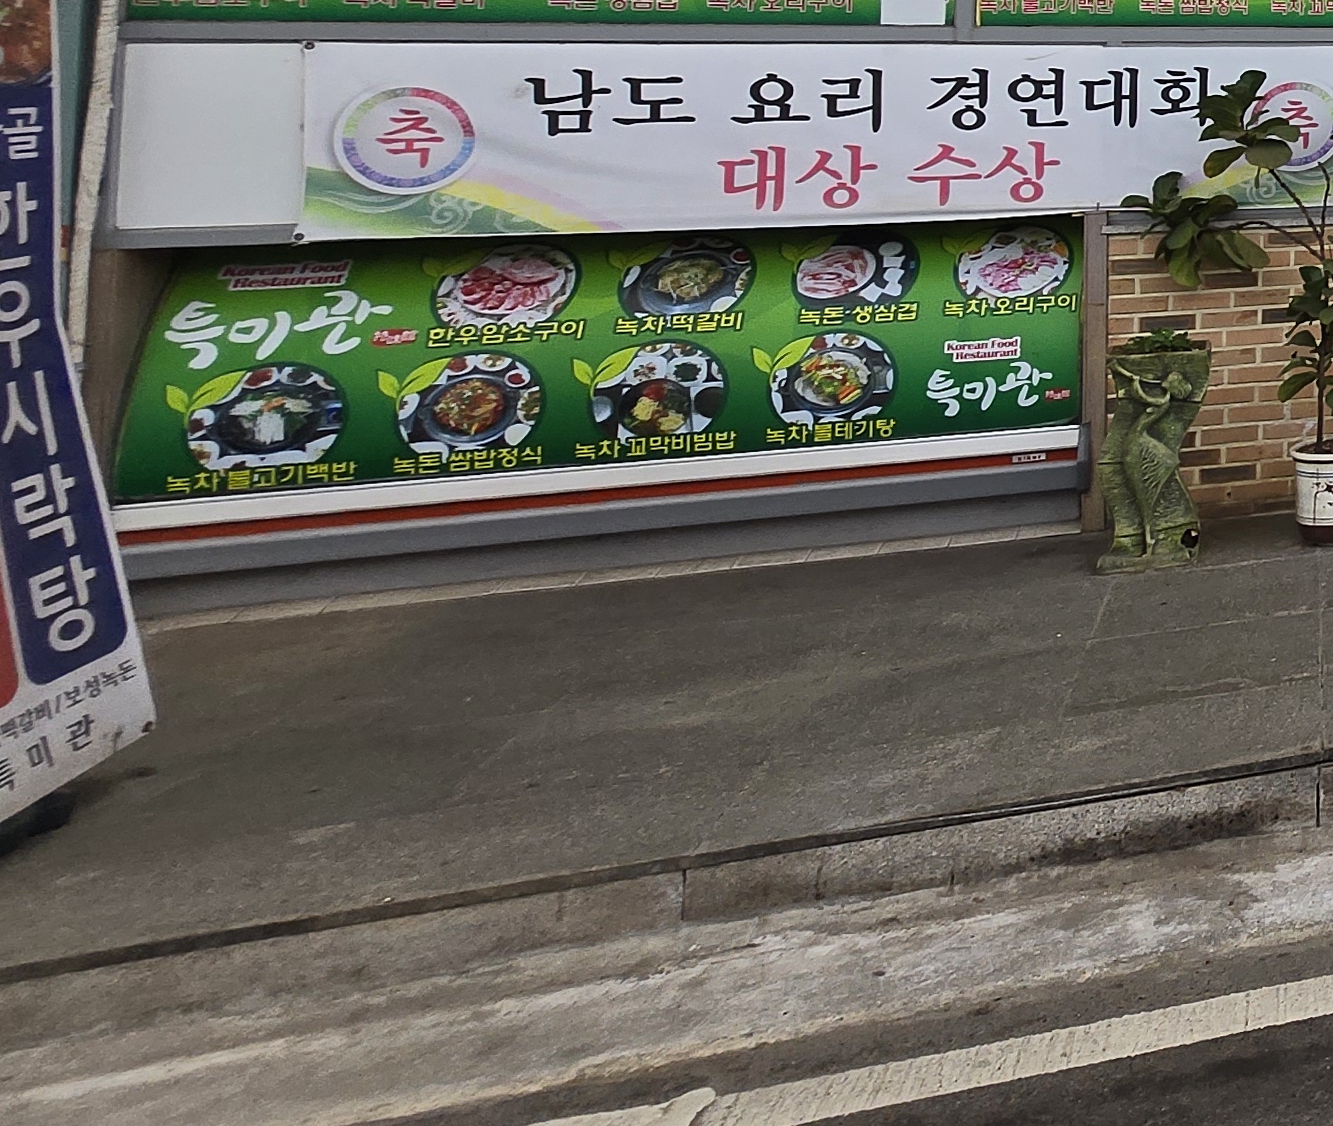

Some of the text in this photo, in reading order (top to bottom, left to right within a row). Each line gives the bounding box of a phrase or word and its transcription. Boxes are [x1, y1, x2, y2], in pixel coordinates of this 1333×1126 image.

[525, 65, 1207, 137] 남도 요리 경연대회
[374, 107, 444, 169] 축
[717, 139, 1062, 213] 대상 수상
[298, 260, 350, 274] Food
[232, 274, 344, 290] Restaurant
[799, 302, 918, 327] 녹돈 생삼겹
[943, 292, 1078, 320] 녹차 오리구이
[164, 289, 394, 370] 특미관
[426, 319, 587, 348] 한우암소구이
[614, 311, 744, 337] 녹차 떡갈비
[946, 337, 1019, 353] Korean Food
[954, 347, 1019, 361] Restaurant
[925, 360, 1053, 417] 특미관
[574, 430, 737, 460] 녹차 꼬막비빔밥
[765, 423, 809, 445] 녹차
[393, 445, 543, 474] 녹돈 쌈밥정식
[166, 460, 358, 495] 녹차 불고기백반
